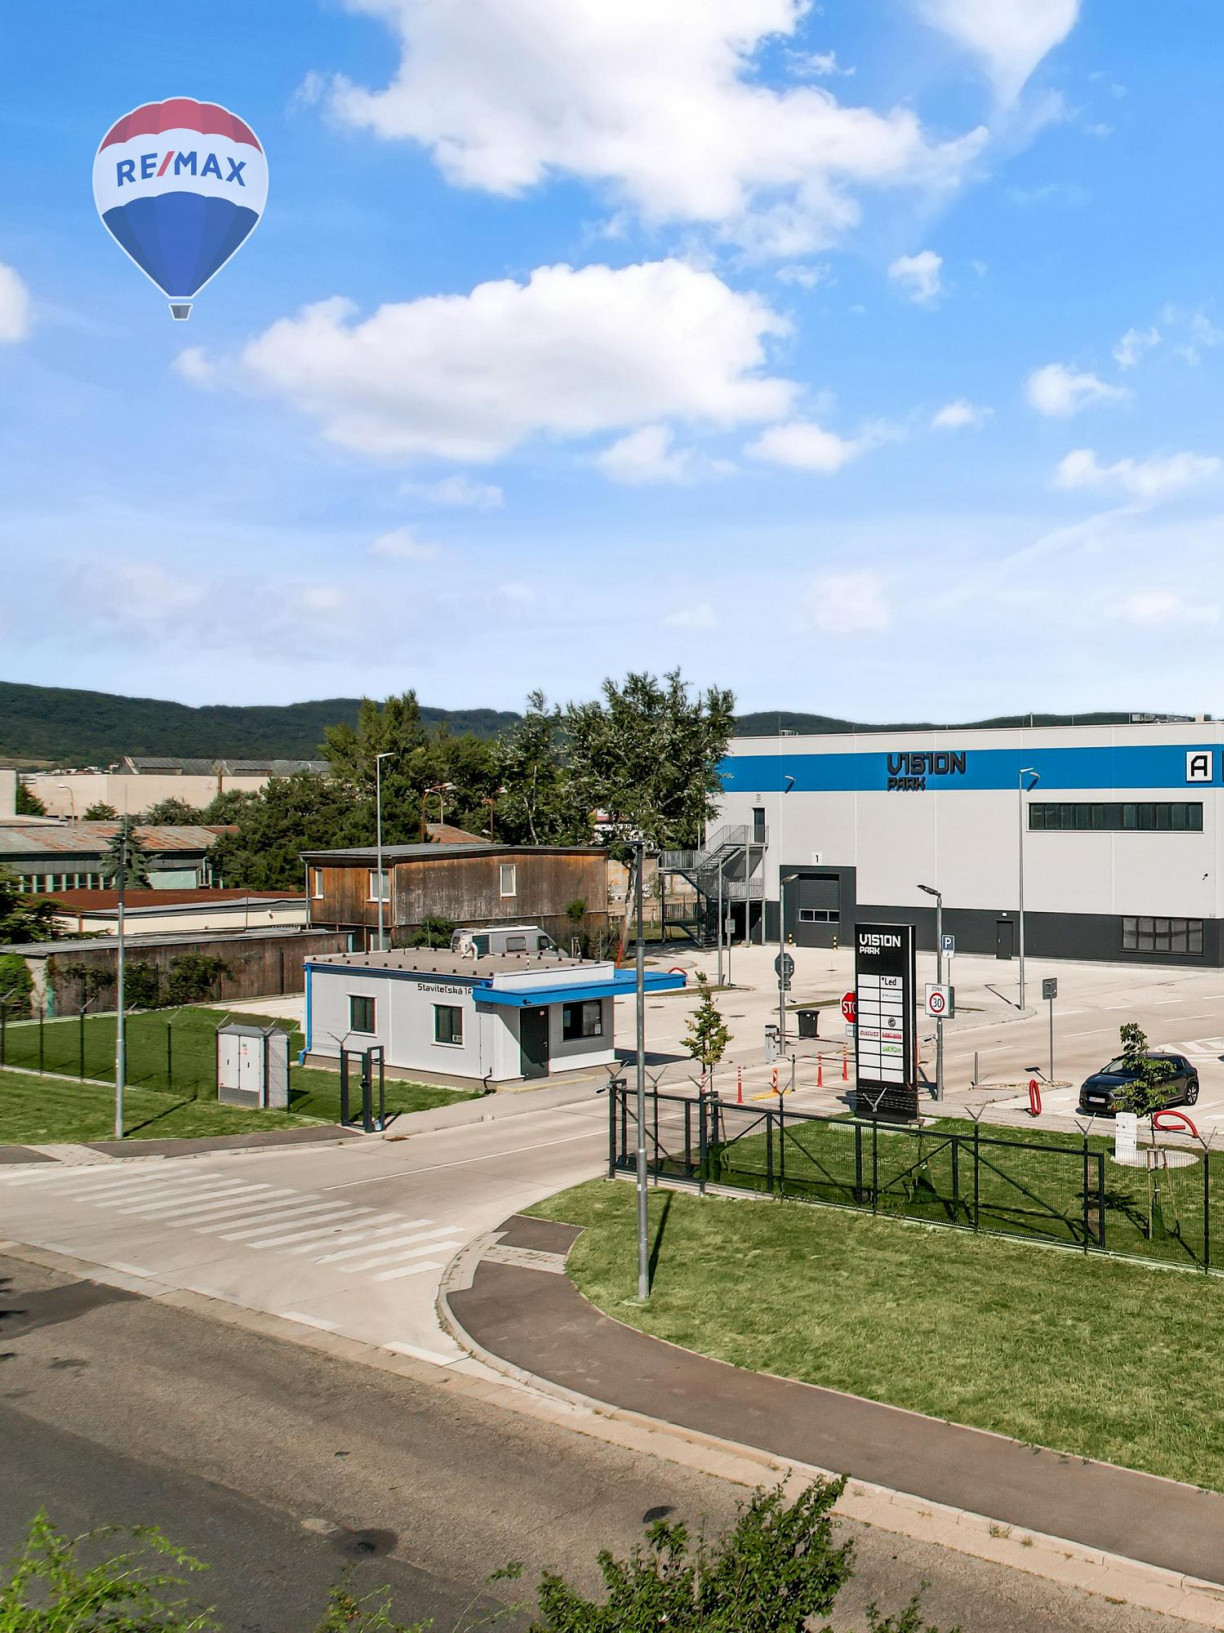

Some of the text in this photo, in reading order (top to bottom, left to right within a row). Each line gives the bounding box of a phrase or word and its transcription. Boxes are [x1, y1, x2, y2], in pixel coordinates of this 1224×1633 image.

[1190, 755, 1207, 777] A
[887, 776, 926, 792] PARK
[944, 937, 952, 949] P
[859, 946, 880, 955] PARK
[884, 977, 897, 986] Led
[932, 998, 942, 1008] 30
